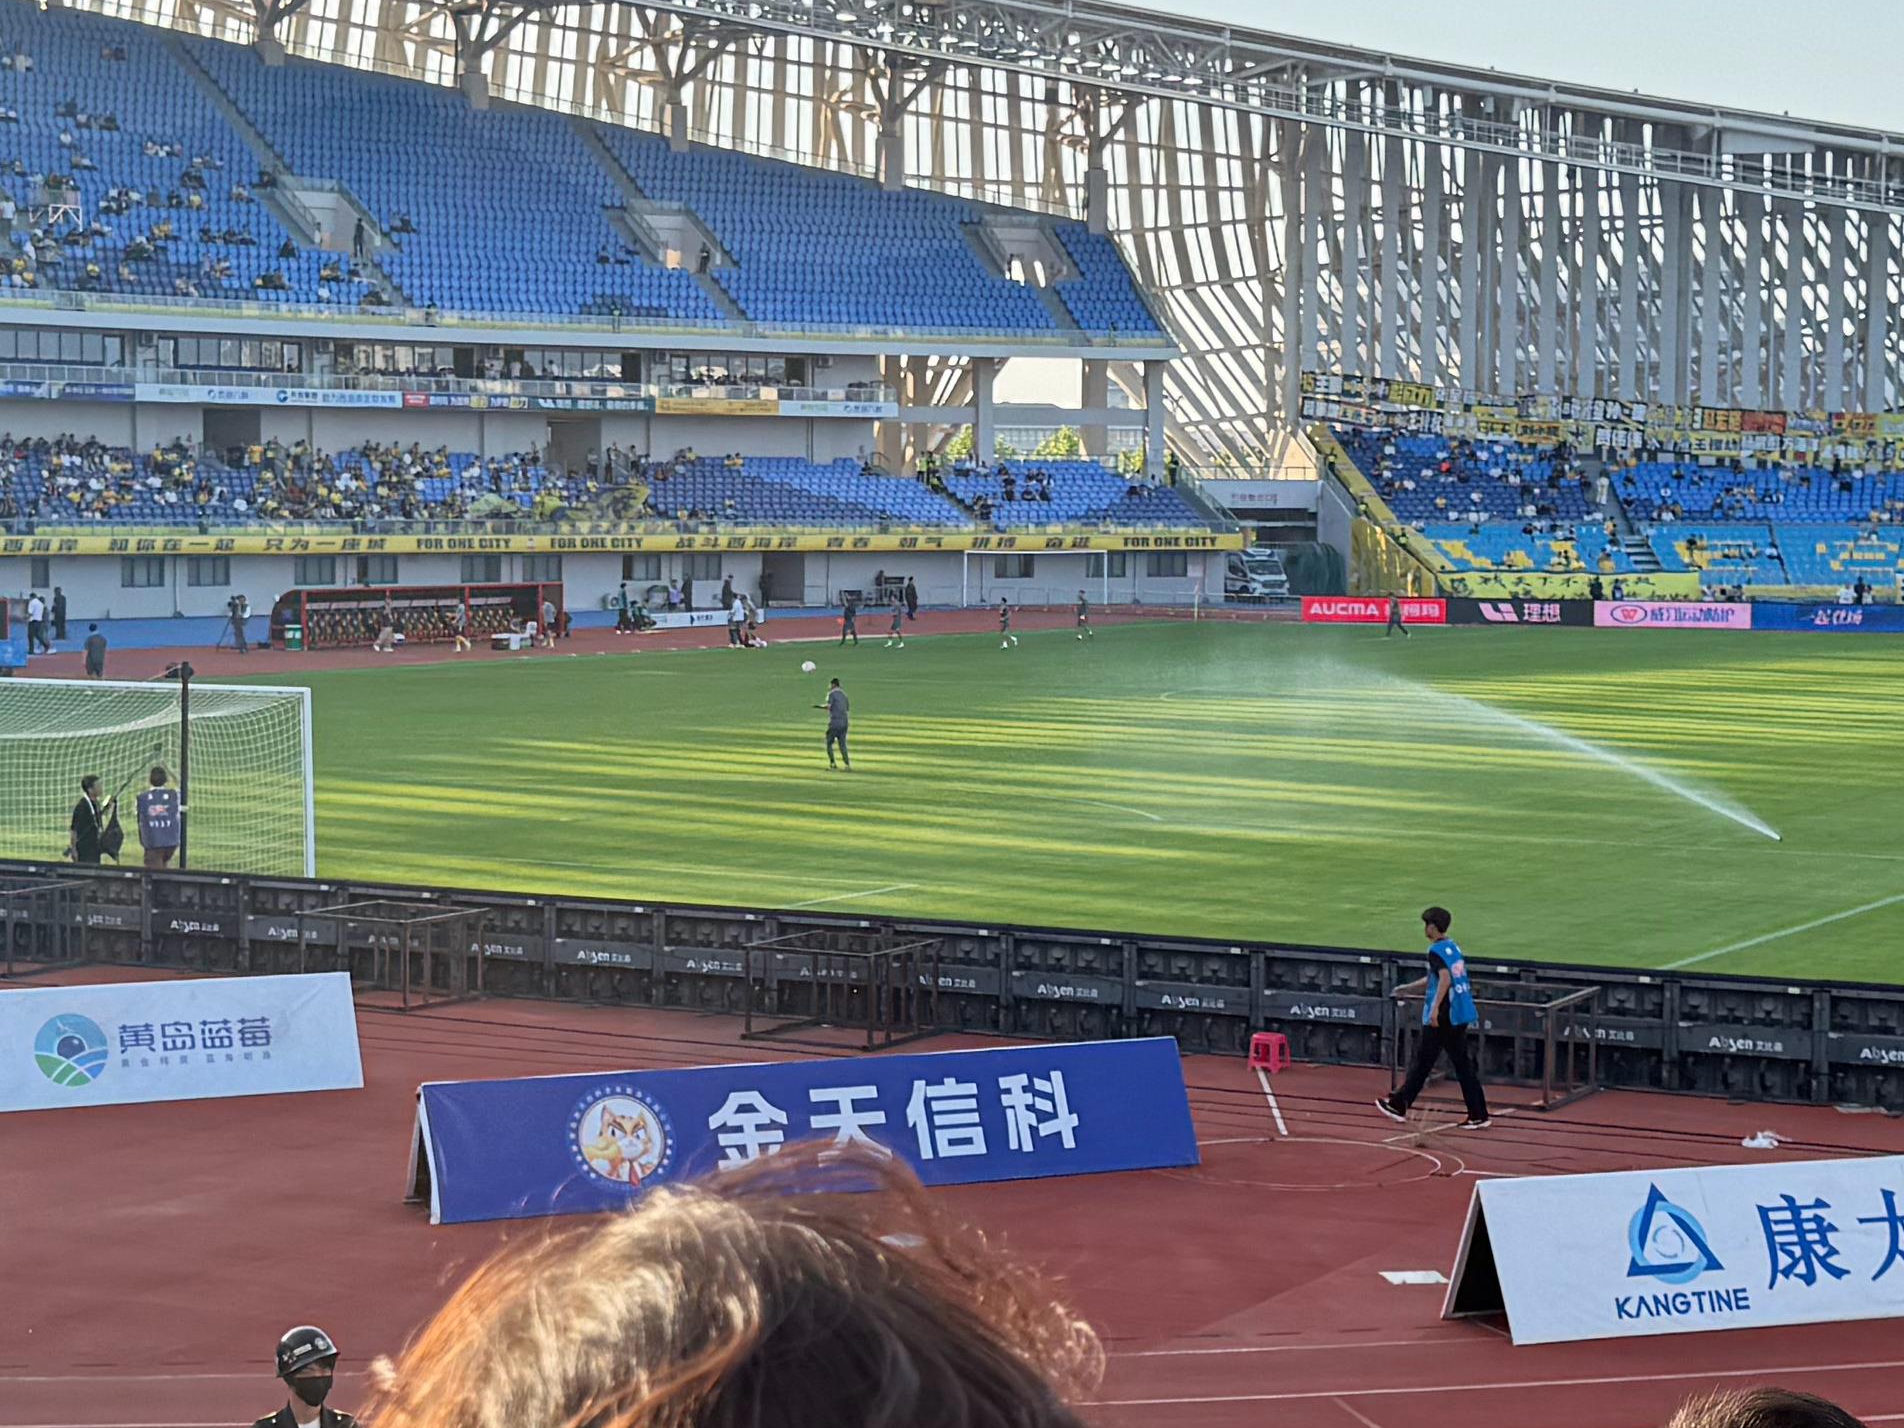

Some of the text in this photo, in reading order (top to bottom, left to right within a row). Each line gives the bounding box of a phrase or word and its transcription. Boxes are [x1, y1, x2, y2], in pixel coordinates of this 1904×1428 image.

[416, 538, 444, 551] FOR
[447, 538, 475, 551] ONE
[478, 538, 512, 551] CITY
[549, 537, 578, 550] FOR
[580, 537, 607, 550] ONE
[610, 537, 644, 550] CITY
[1123, 537, 1151, 548] FOR
[1154, 537, 1181, 548] ONE
[1184, 537, 1217, 548] CITY
[1309, 602, 1379, 615] AUCMA
[1523, 603, 1561, 623] 理想
[118, 1014, 273, 1056] 黄岛蓝莓
[707, 1069, 1081, 1172] 金天信科
[1615, 1286, 1751, 1320] KANGTINE
